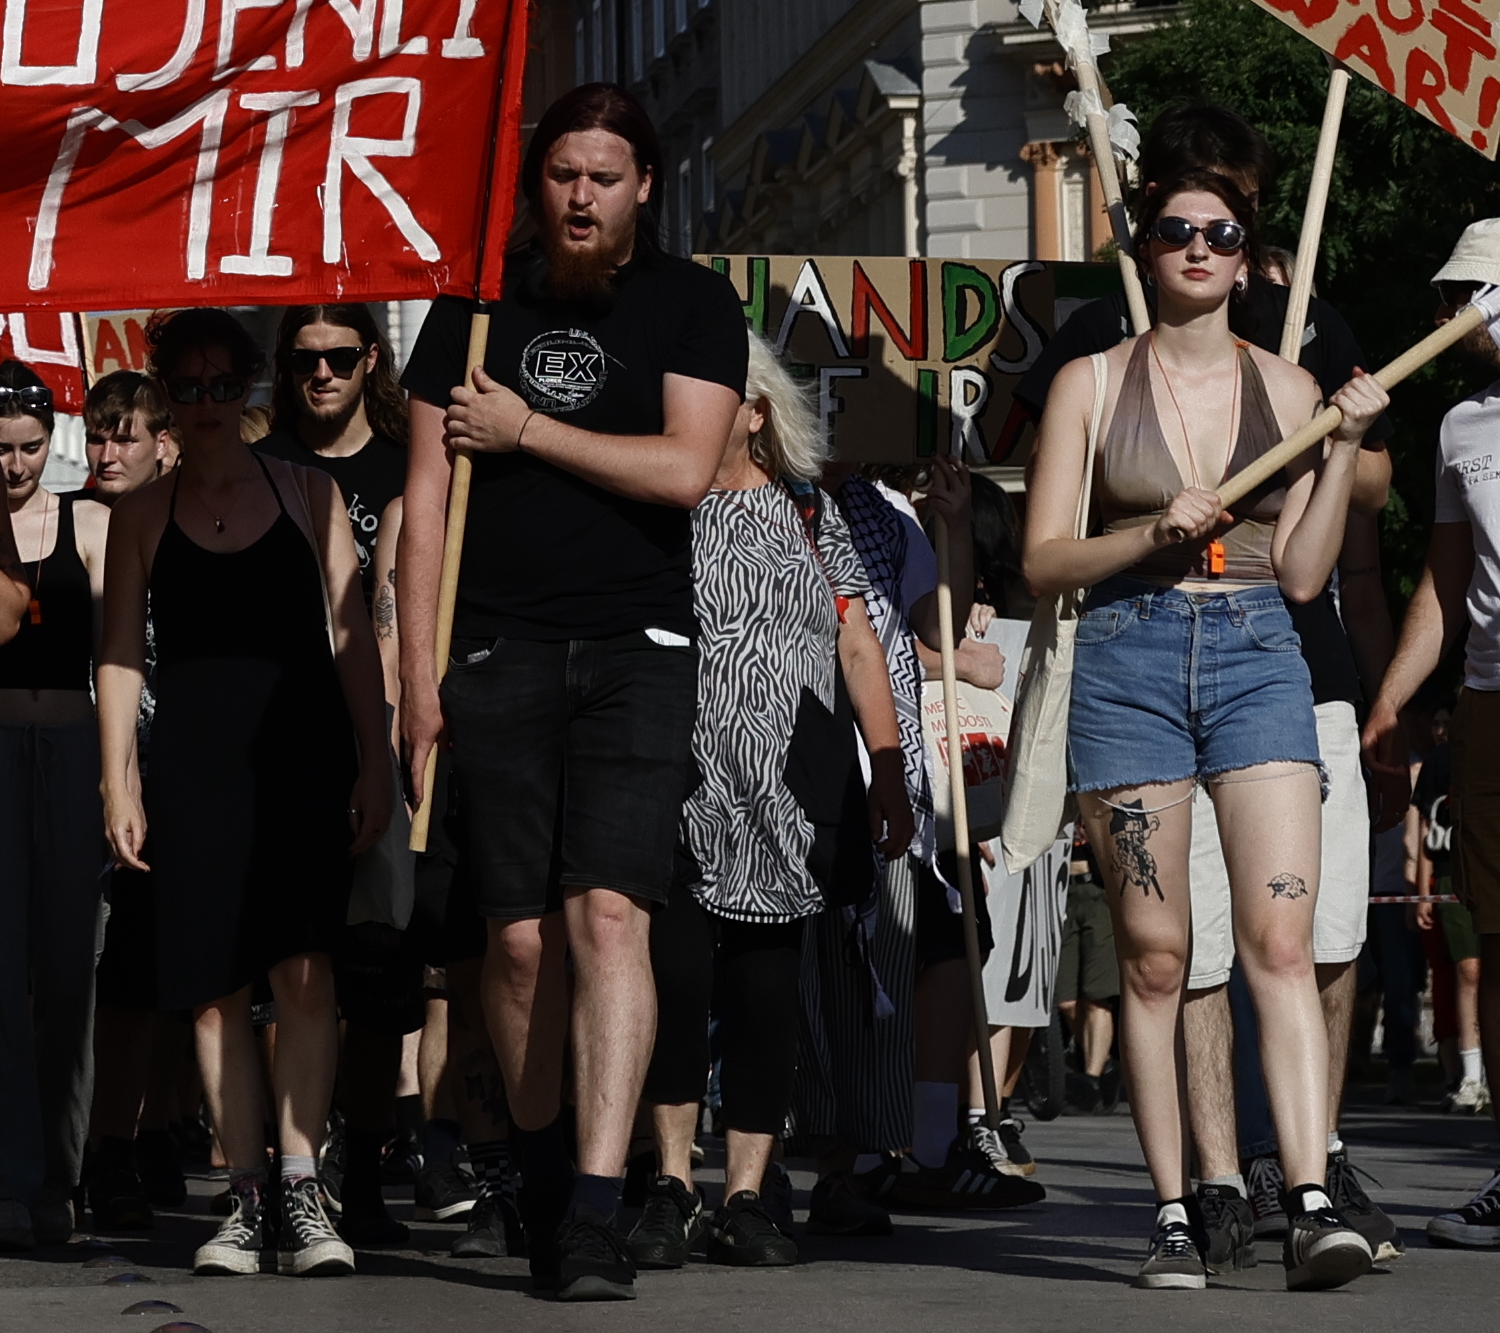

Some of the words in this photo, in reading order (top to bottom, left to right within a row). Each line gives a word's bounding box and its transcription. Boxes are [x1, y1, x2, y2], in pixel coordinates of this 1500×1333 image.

[27, 77, 442, 291] MIR
[535, 350, 599, 382] EX
[711, 257, 1049, 374] HANDS
